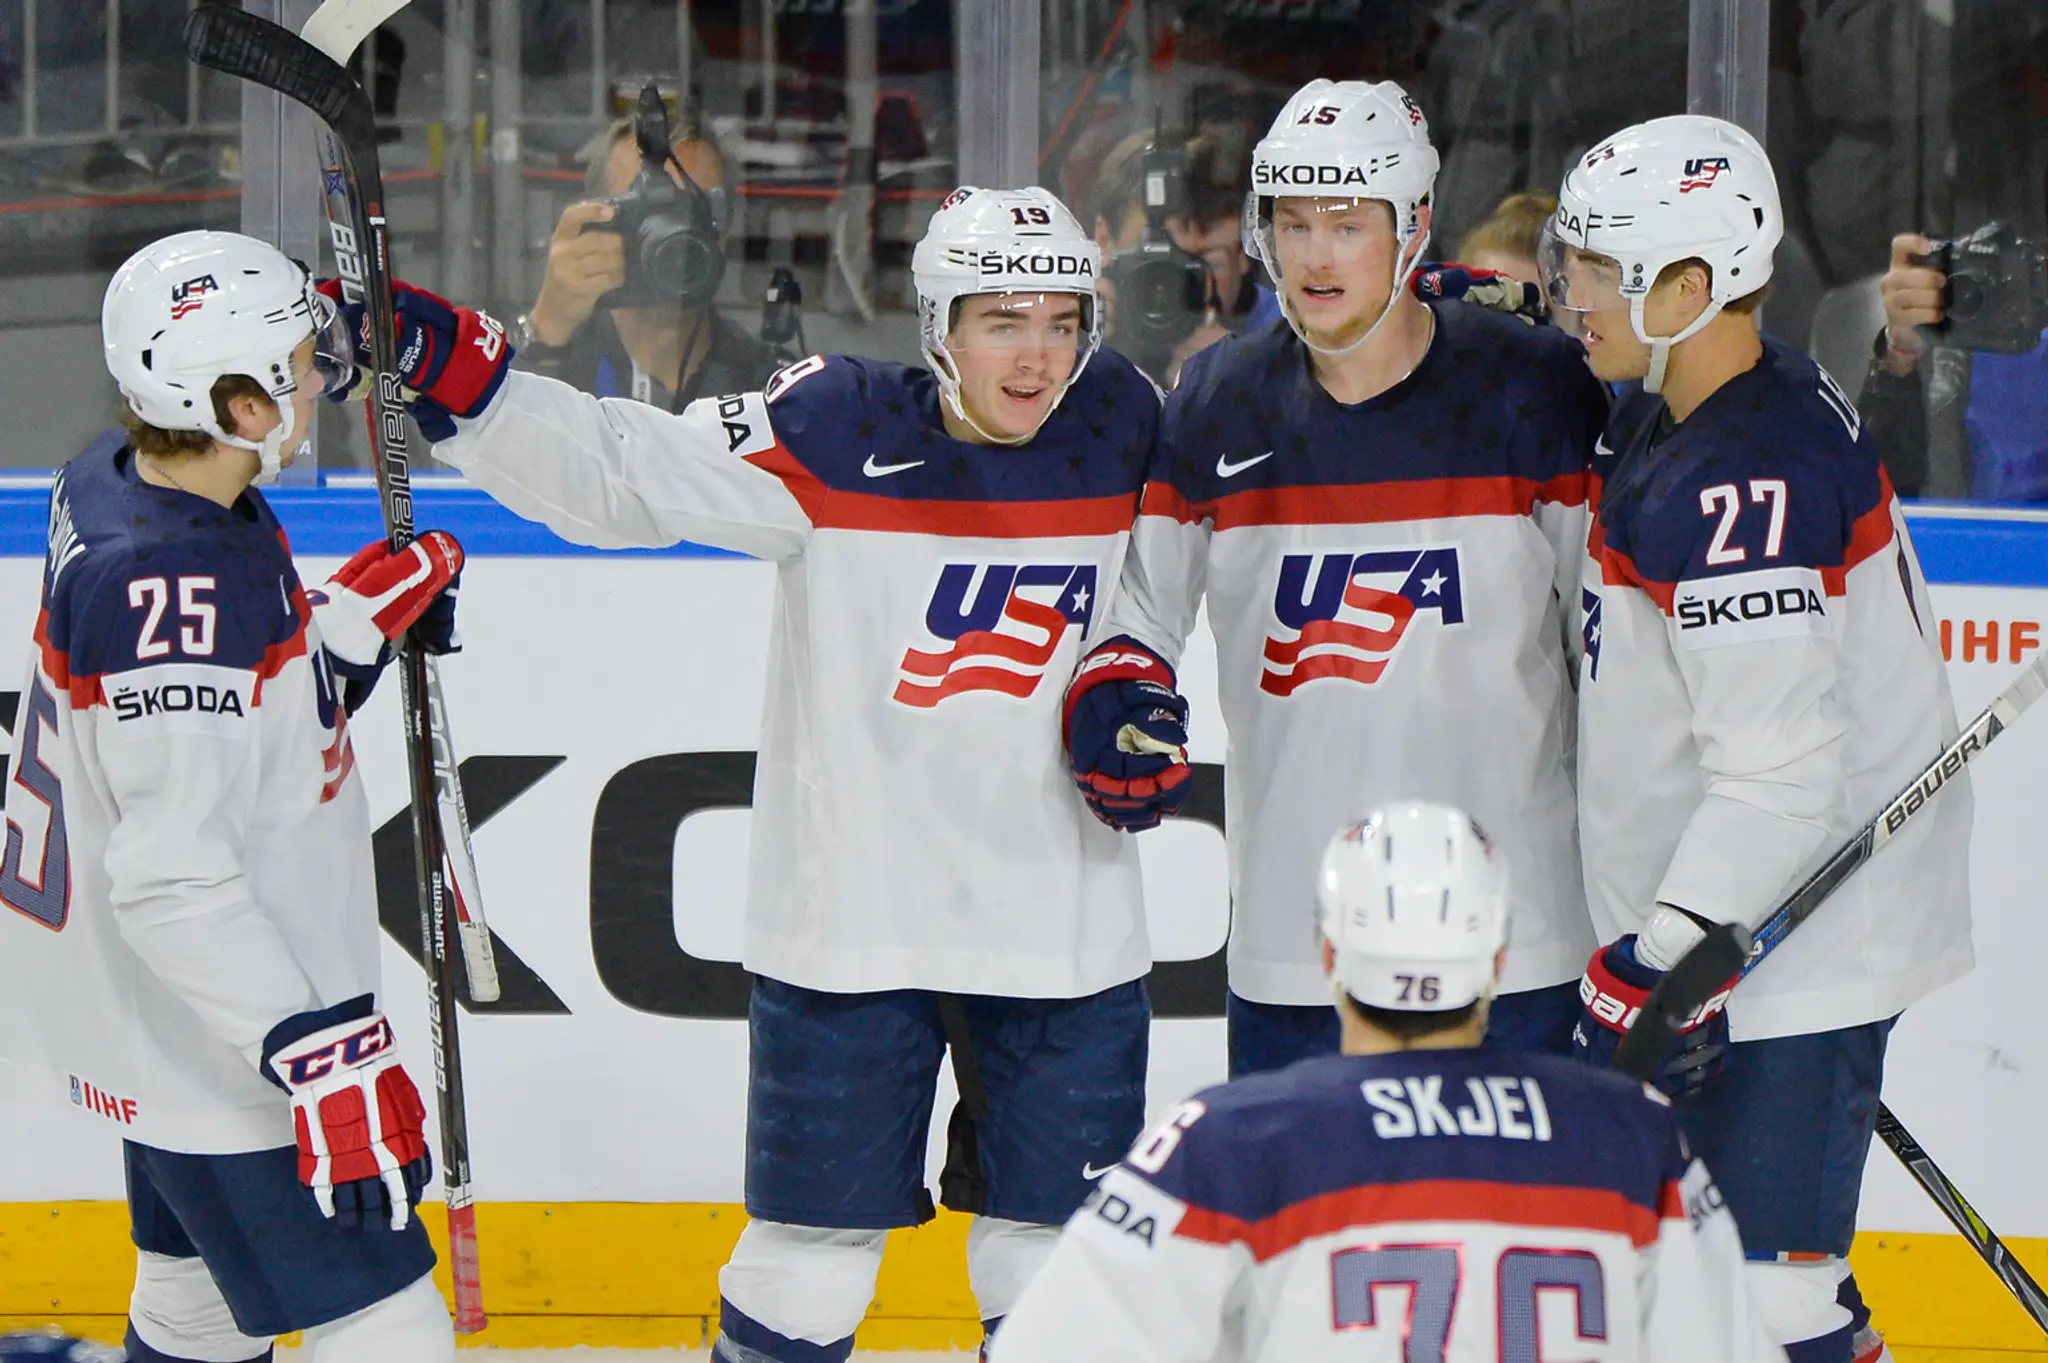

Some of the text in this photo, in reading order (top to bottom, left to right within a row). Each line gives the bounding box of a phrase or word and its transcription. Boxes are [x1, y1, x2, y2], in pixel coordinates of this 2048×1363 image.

[1297, 104, 1341, 126] 15
[1255, 160, 1368, 185] ŠKODA
[1681, 157, 1731, 185] USA
[1010, 207, 1051, 226] 19
[980, 250, 1094, 278] ŠKODA
[171, 274, 219, 310] USA
[765, 354, 827, 405] 9
[1700, 479, 1787, 567] 27
[127, 575, 217, 661] 25
[908, 563, 1098, 675] USA
[1268, 547, 1465, 665] USA
[1677, 587, 1826, 630] ŠKODA
[1940, 618, 2040, 665] IHF
[112, 684, 245, 722] ŠKODA
[0, 662, 71, 933] 5
[1394, 974, 1441, 1003] 76
[84, 1081, 138, 1125] IIHF
[1360, 1075, 1552, 1141] SKJEI
[1126, 1098, 1206, 1174] 6
